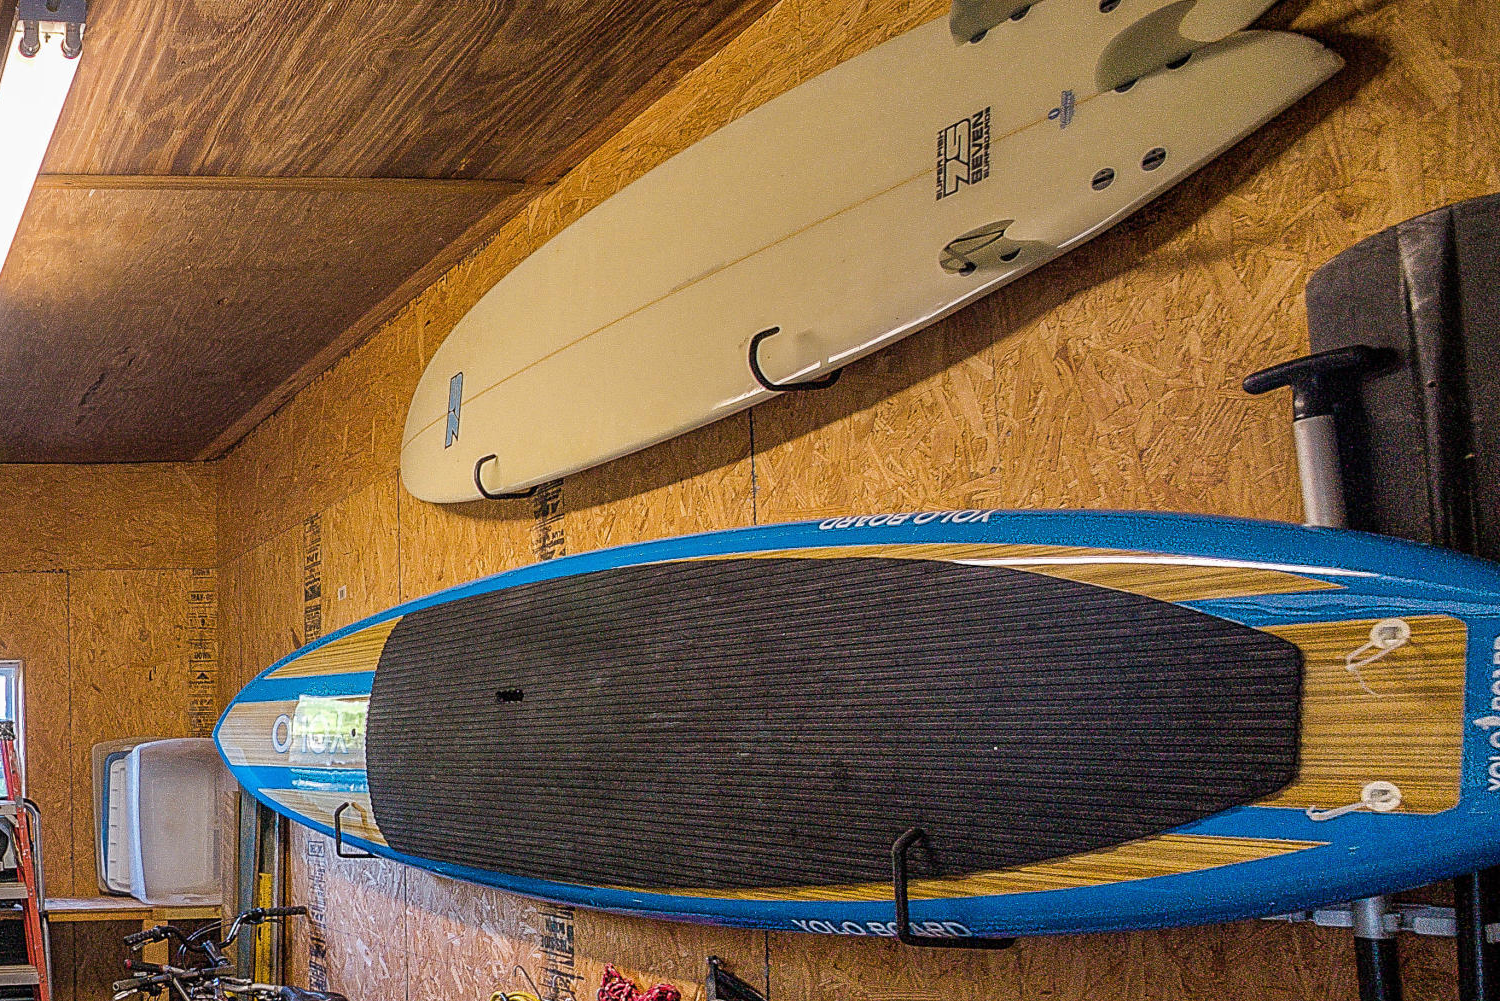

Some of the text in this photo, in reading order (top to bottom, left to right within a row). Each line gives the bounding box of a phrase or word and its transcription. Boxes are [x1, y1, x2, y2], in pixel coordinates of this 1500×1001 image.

[971, 109, 984, 186] SEVEN
[936, 162, 944, 201] SUPER
[818, 508, 1000, 530] YOLO BOARD
[791, 919, 866, 936] YOLO
